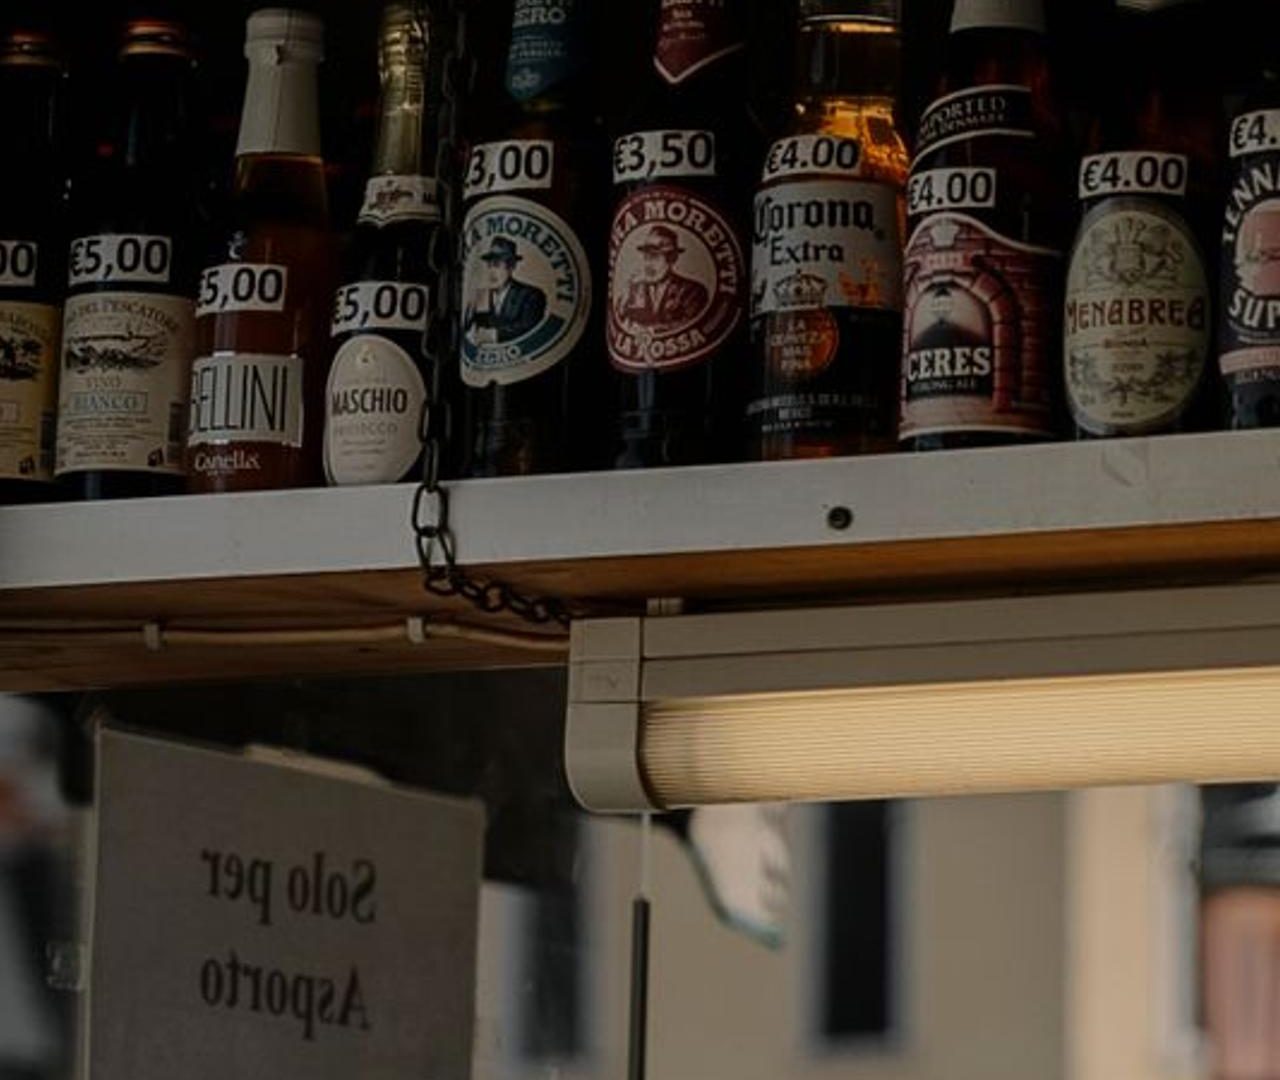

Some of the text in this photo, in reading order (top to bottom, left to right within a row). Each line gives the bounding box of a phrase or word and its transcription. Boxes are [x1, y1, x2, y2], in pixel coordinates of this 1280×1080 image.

[464, 144, 550, 187] 3,00
[615, 132, 713, 177] €3,50
[767, 137, 861, 173] €4.00
[1083, 155, 1185, 191] €4.00
[909, 172, 993, 210] €4.00
[1222, 163, 1280, 243] TENN
[753, 196, 874, 244] Corona
[69, 238, 169, 278] €5,00
[486, 215, 576, 304] MORETTI
[643, 200, 738, 295] MORETTI
[770, 236, 844, 265] Extra
[196, 267, 283, 309] 5,00
[907, 345, 991, 382] CERES
